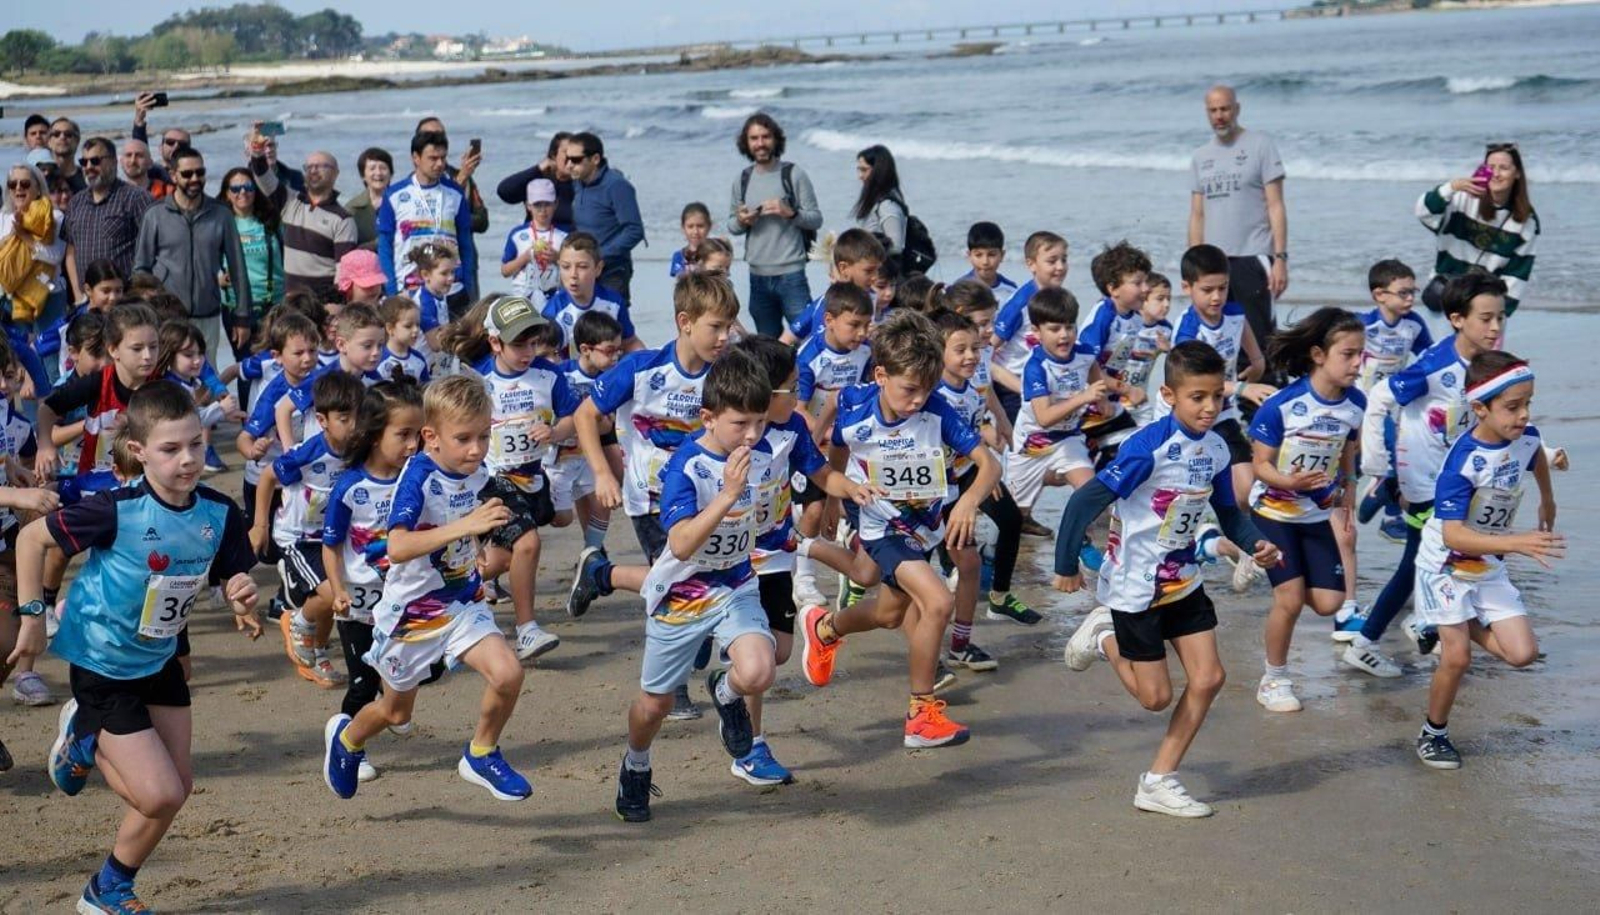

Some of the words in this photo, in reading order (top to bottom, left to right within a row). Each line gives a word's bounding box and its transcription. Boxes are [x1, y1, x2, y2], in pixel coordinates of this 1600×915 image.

[1291, 454, 1330, 471] 475
[883, 466, 931, 486] 348
[704, 531, 749, 555] 330
[351, 587, 383, 611] 32
